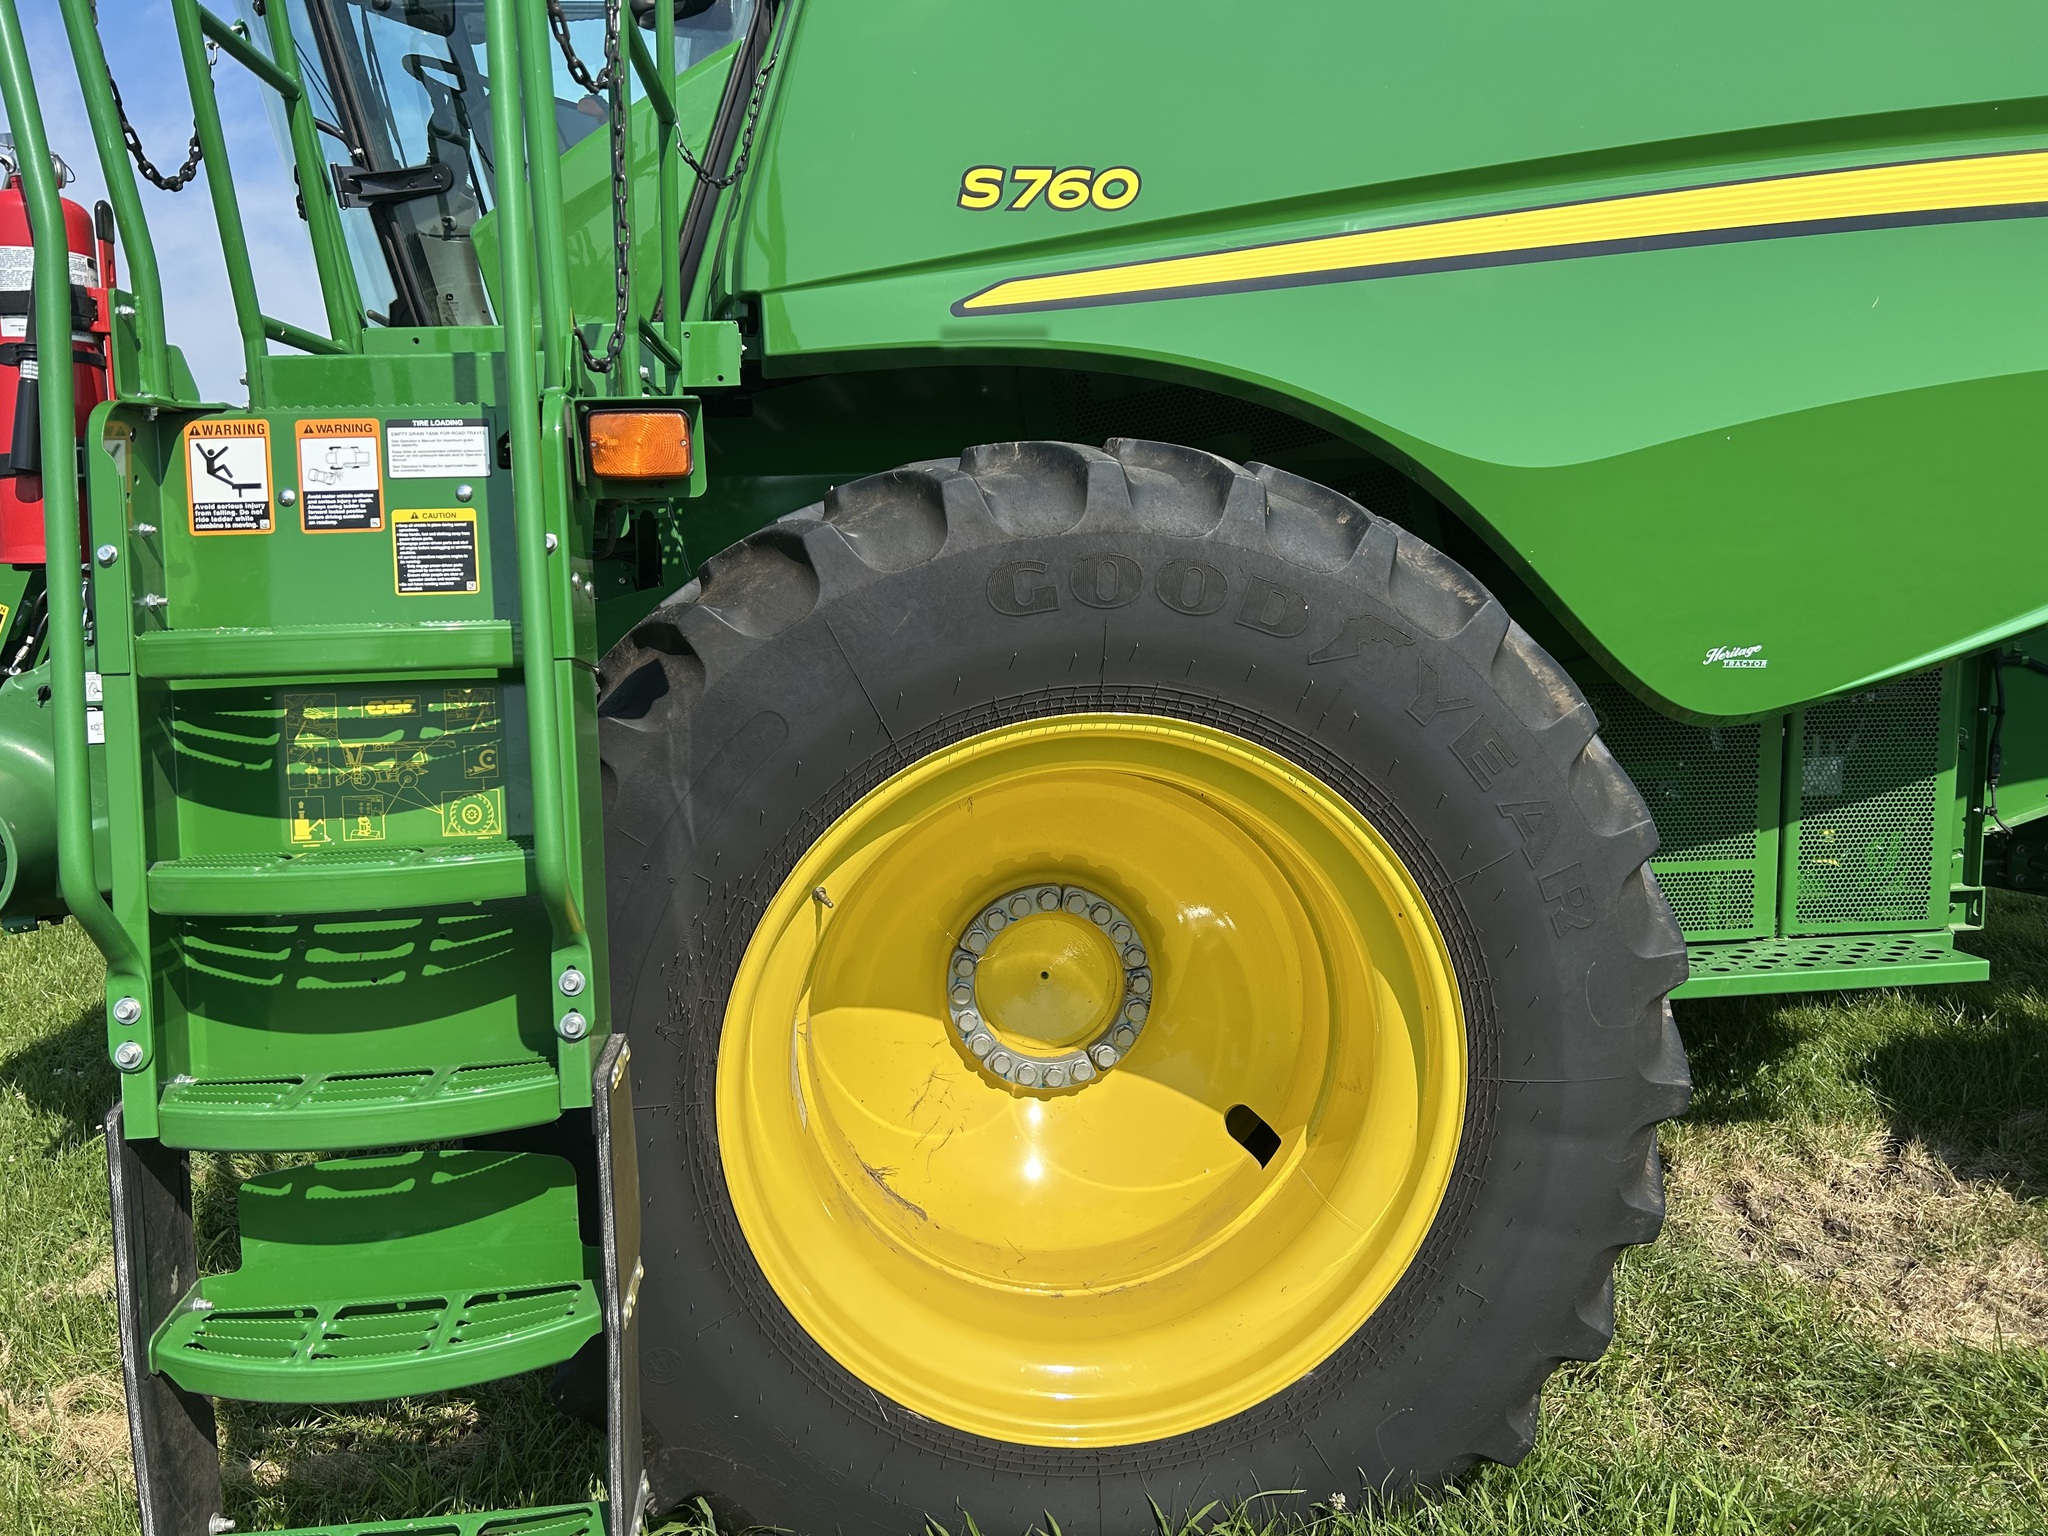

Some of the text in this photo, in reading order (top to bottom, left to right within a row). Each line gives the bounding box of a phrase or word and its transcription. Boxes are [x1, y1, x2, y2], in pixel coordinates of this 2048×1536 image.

[957, 165, 1142, 212] S760
[202, 423, 266, 436] WARNING
[316, 423, 373, 434] WARNING
[244, 502, 266, 510] injury
[212, 509, 238, 517] falling.
[1702, 644, 1763, 665] Heritage
[1722, 659, 1768, 668] TRACTOR
